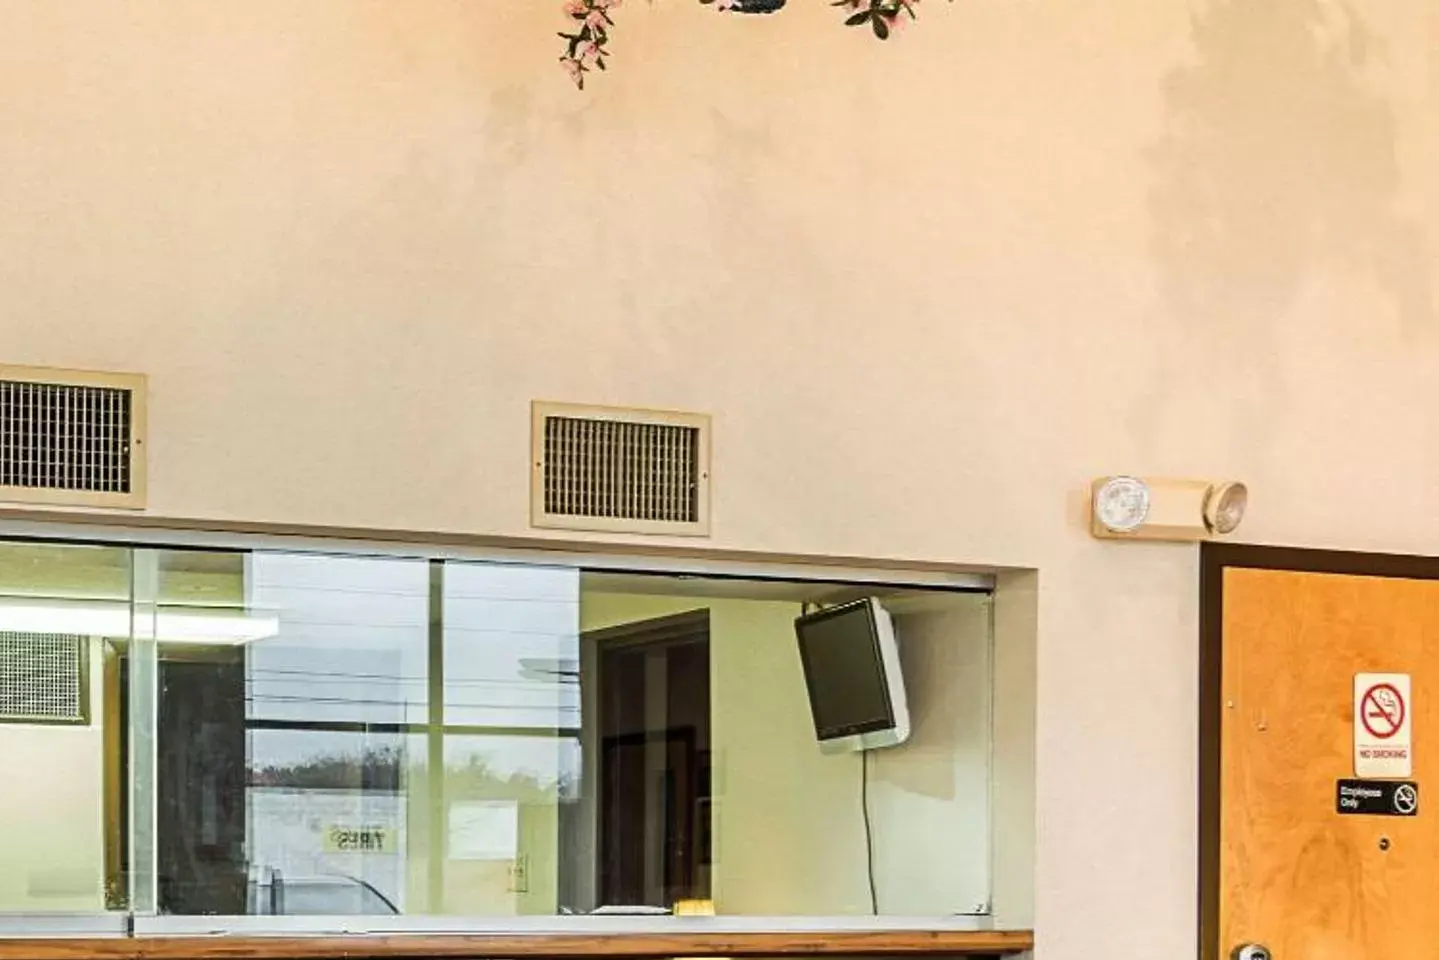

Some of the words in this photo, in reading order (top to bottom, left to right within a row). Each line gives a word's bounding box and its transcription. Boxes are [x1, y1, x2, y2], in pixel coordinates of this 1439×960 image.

[1359, 750, 1371, 759] NO
[1372, 750, 1407, 759] SMOKING
[1340, 798, 1359, 809] Only
